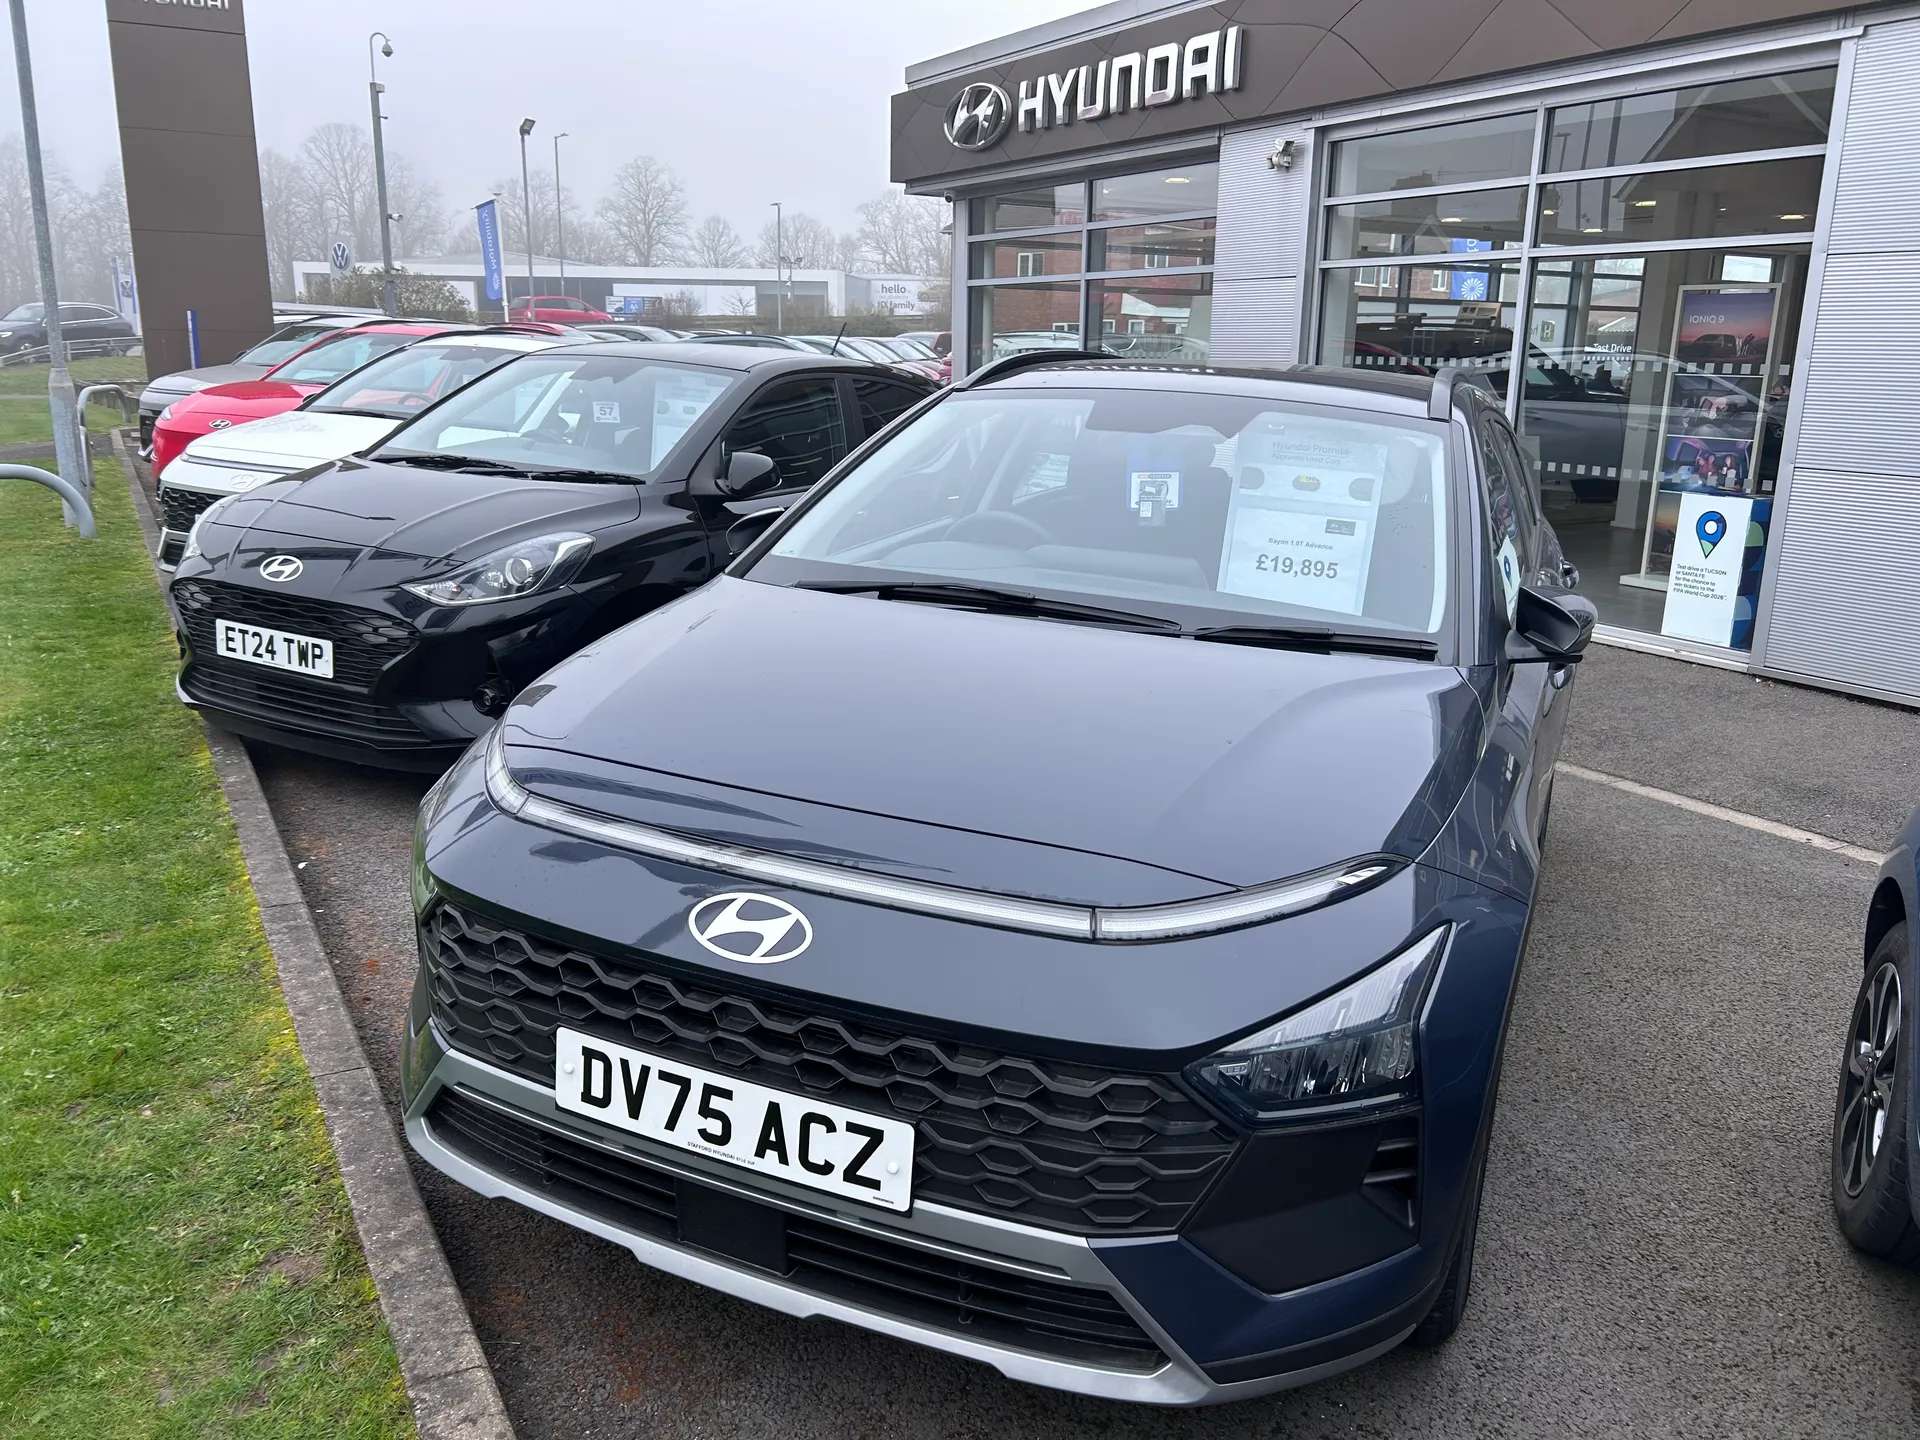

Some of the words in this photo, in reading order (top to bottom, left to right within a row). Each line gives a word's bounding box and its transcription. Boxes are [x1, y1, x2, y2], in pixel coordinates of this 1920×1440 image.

[1017, 25, 1243, 132] HYUNDAI
[881, 284, 906, 294] hello
[889, 300, 915, 311] family
[1718, 315, 1725, 323] 9
[1593, 343, 1610, 352] Test
[1611, 343, 1632, 352] Drive
[599, 406, 614, 416] 57
[1256, 553, 1339, 579] £19,895
[1705, 567, 1727, 576] TUCSON
[225, 625, 277, 661] ET24
[283, 636, 324, 670] TWP
[581, 1045, 734, 1147] DV75
[753, 1100, 885, 1192] ACZ
